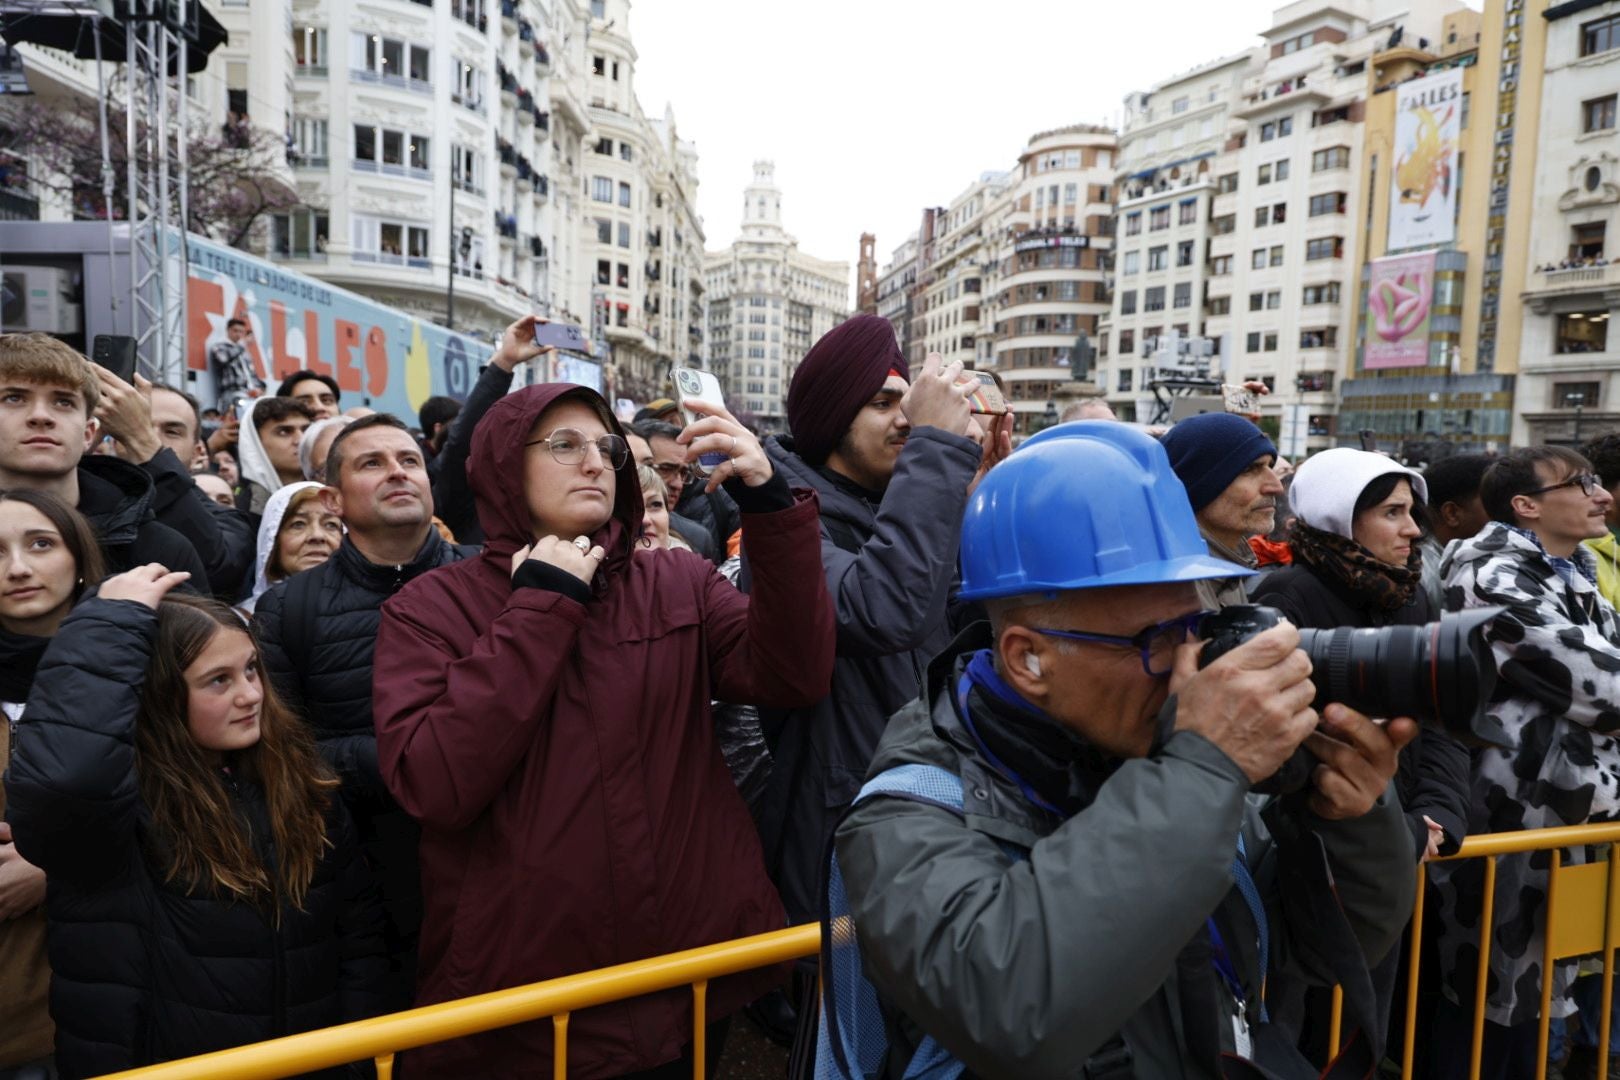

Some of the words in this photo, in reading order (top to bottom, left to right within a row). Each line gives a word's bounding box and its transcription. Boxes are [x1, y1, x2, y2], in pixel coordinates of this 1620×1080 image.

[1400, 82, 1459, 112] FALLES
[207, 252, 236, 277] TELE
[246, 264, 260, 284] LA
[301, 283, 314, 302] DE
[316, 288, 332, 306] LES
[187, 276, 389, 398] FALLES
